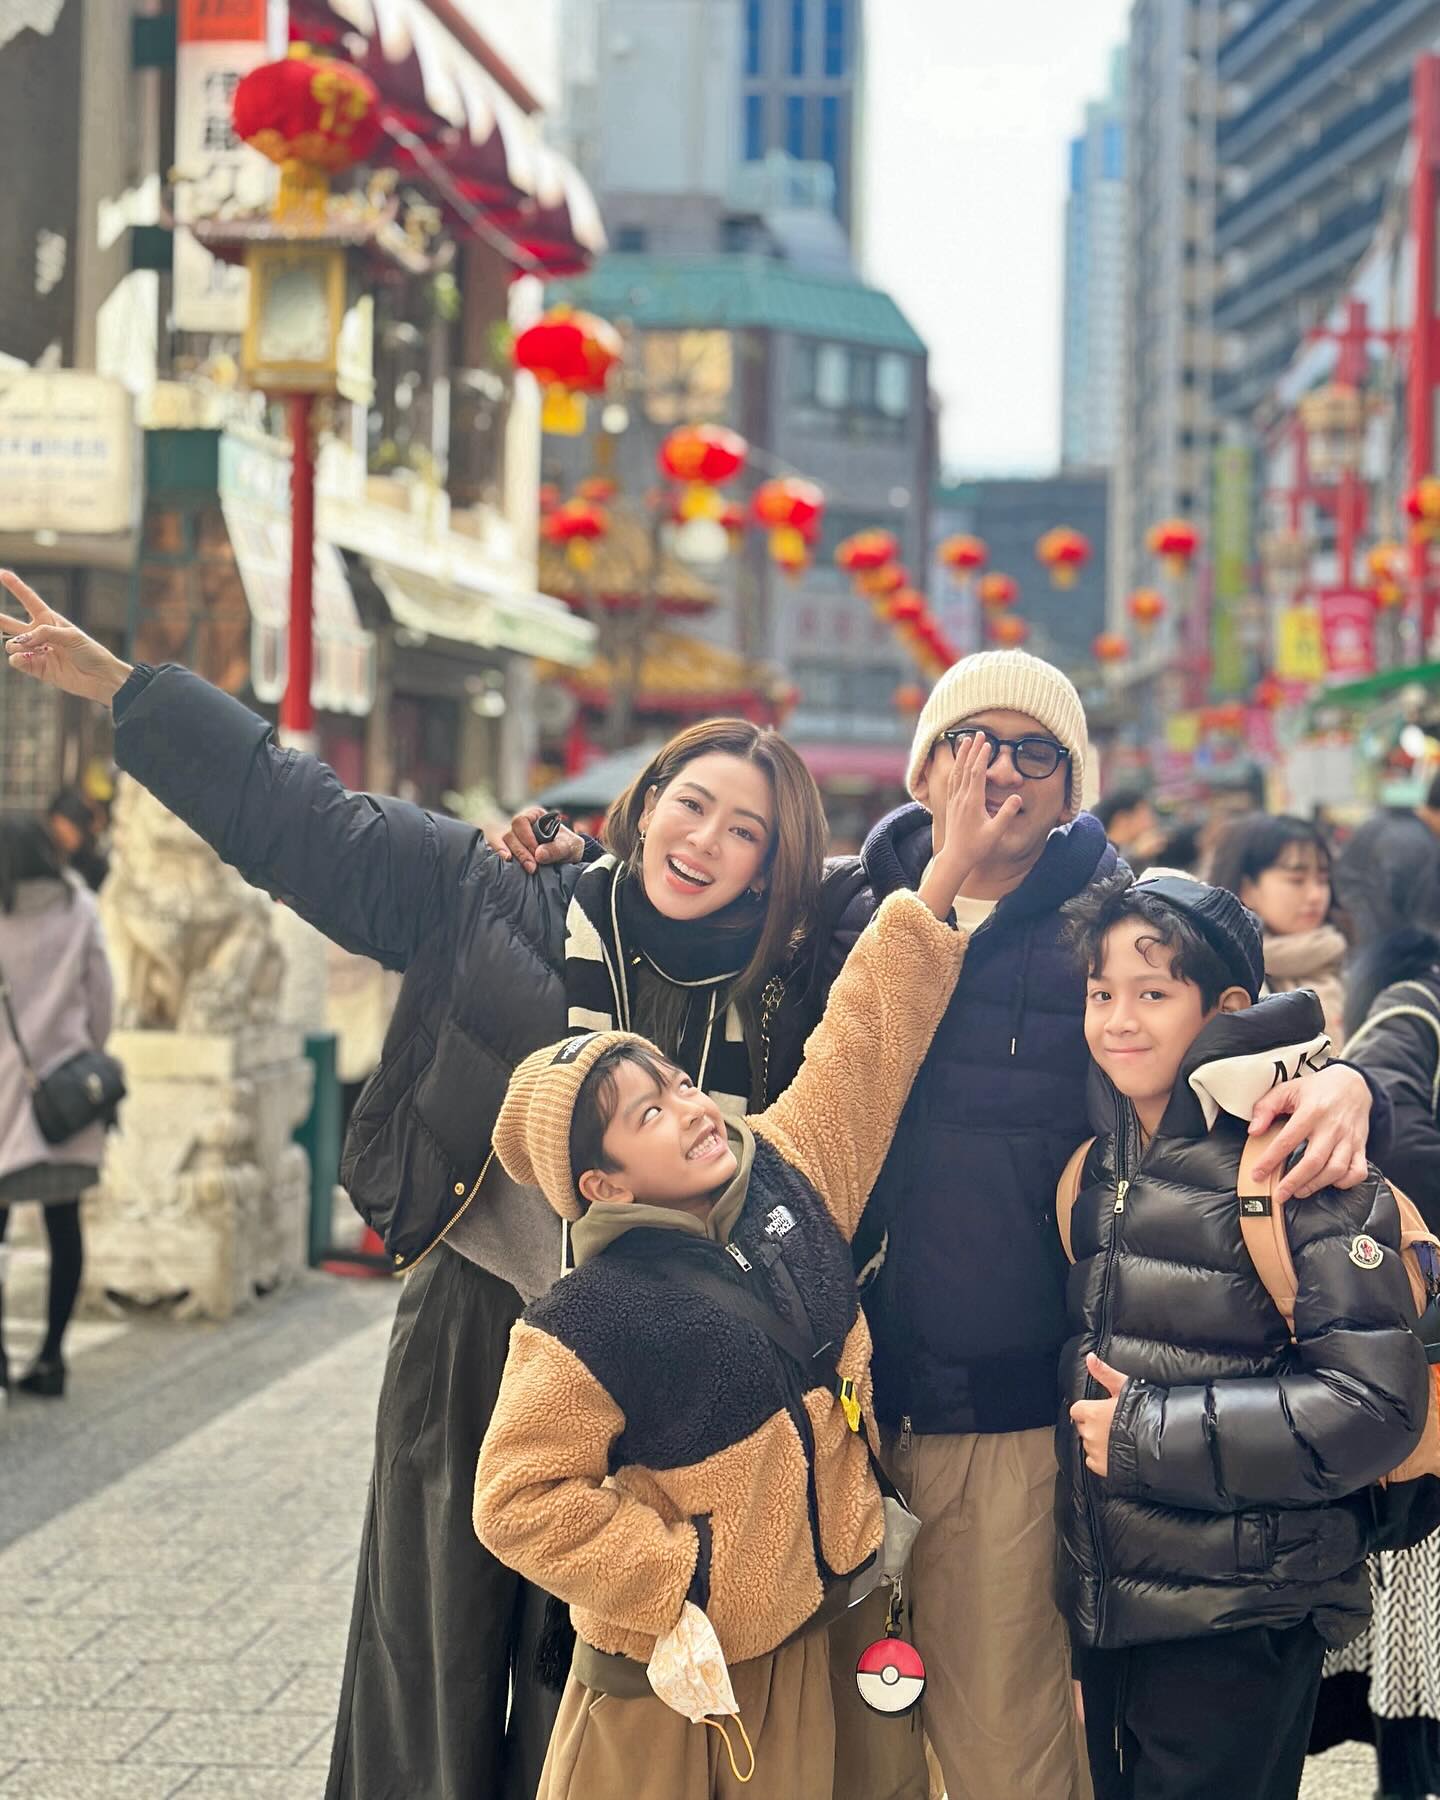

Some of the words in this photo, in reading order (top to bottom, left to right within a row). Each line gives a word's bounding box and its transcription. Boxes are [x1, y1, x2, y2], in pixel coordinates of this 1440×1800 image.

[767, 1206, 783, 1221] THE
[765, 1214, 788, 1235] NORTH
[776, 1220, 793, 1237] FACE
